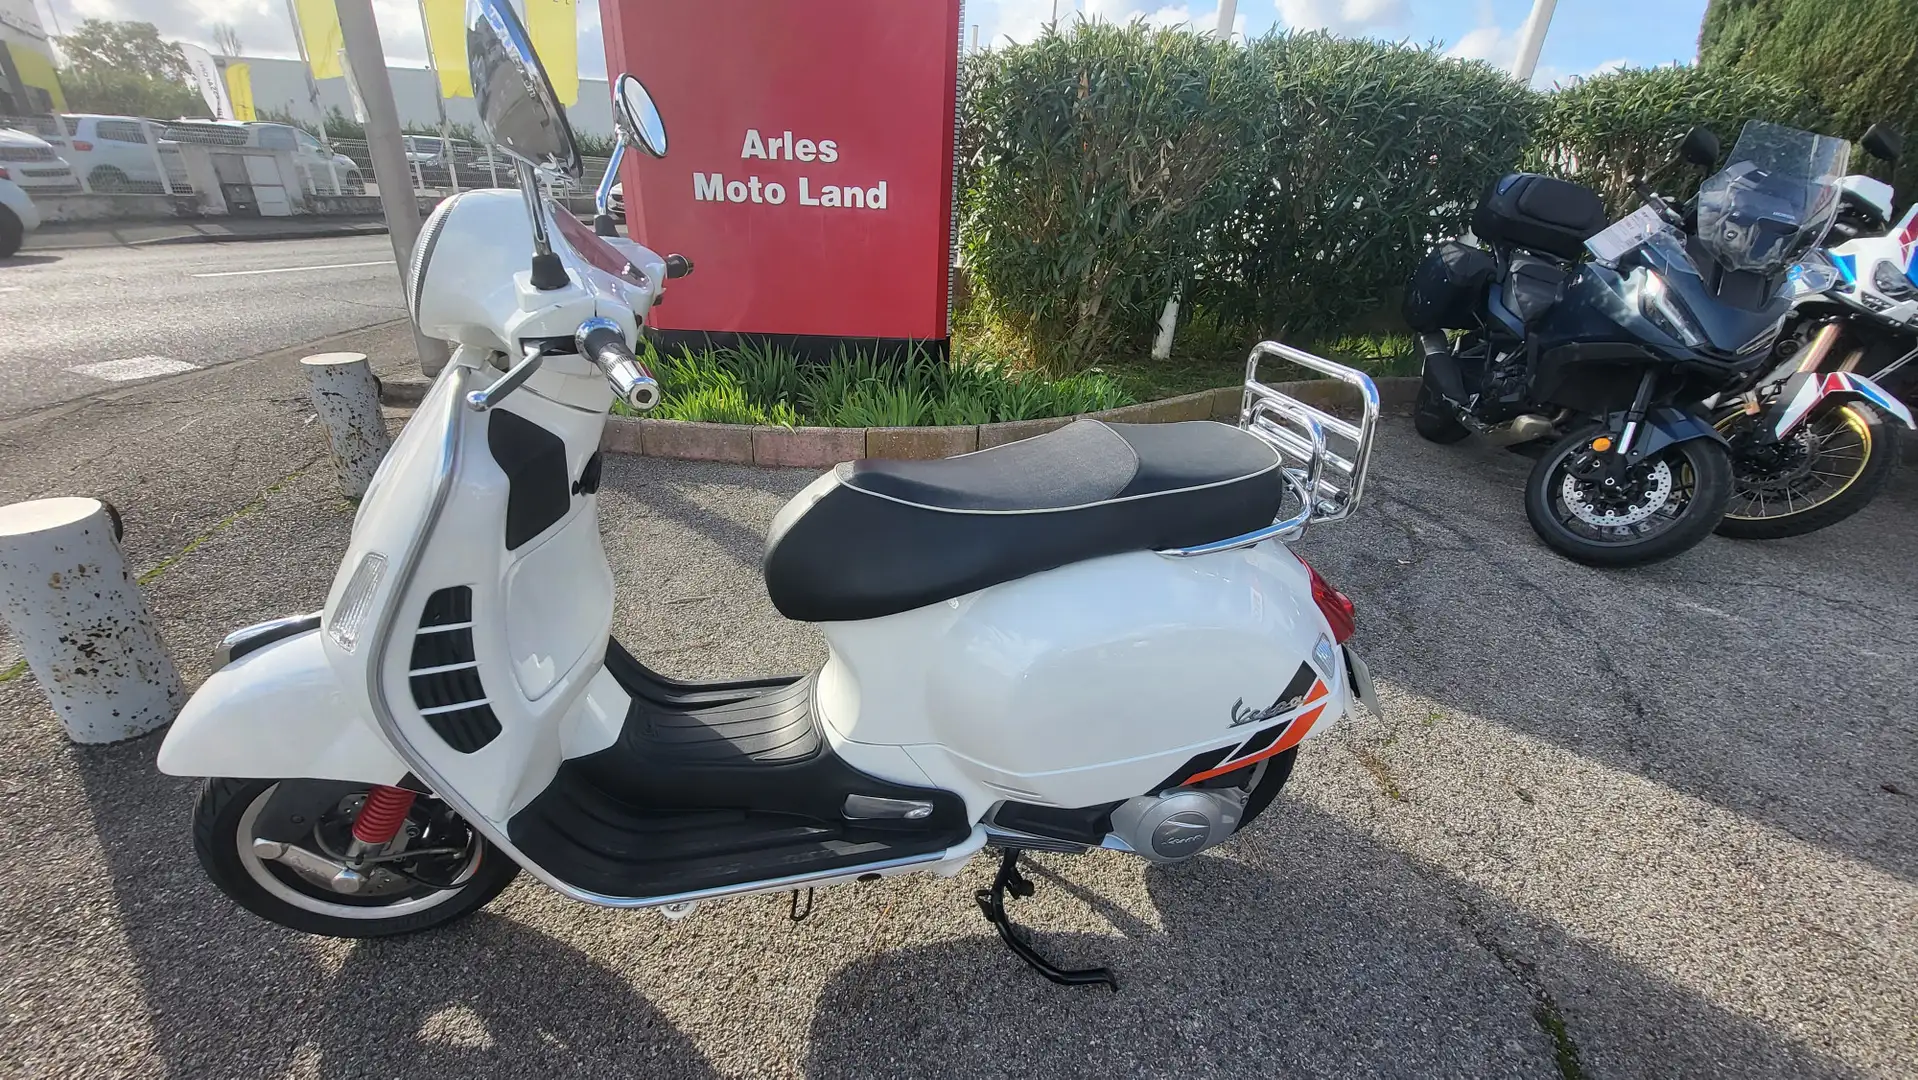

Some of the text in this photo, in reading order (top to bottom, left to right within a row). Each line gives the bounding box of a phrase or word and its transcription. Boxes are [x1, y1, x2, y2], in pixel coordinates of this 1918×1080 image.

[741, 129, 839, 163] Arles
[692, 172, 887, 210] Moto Land
